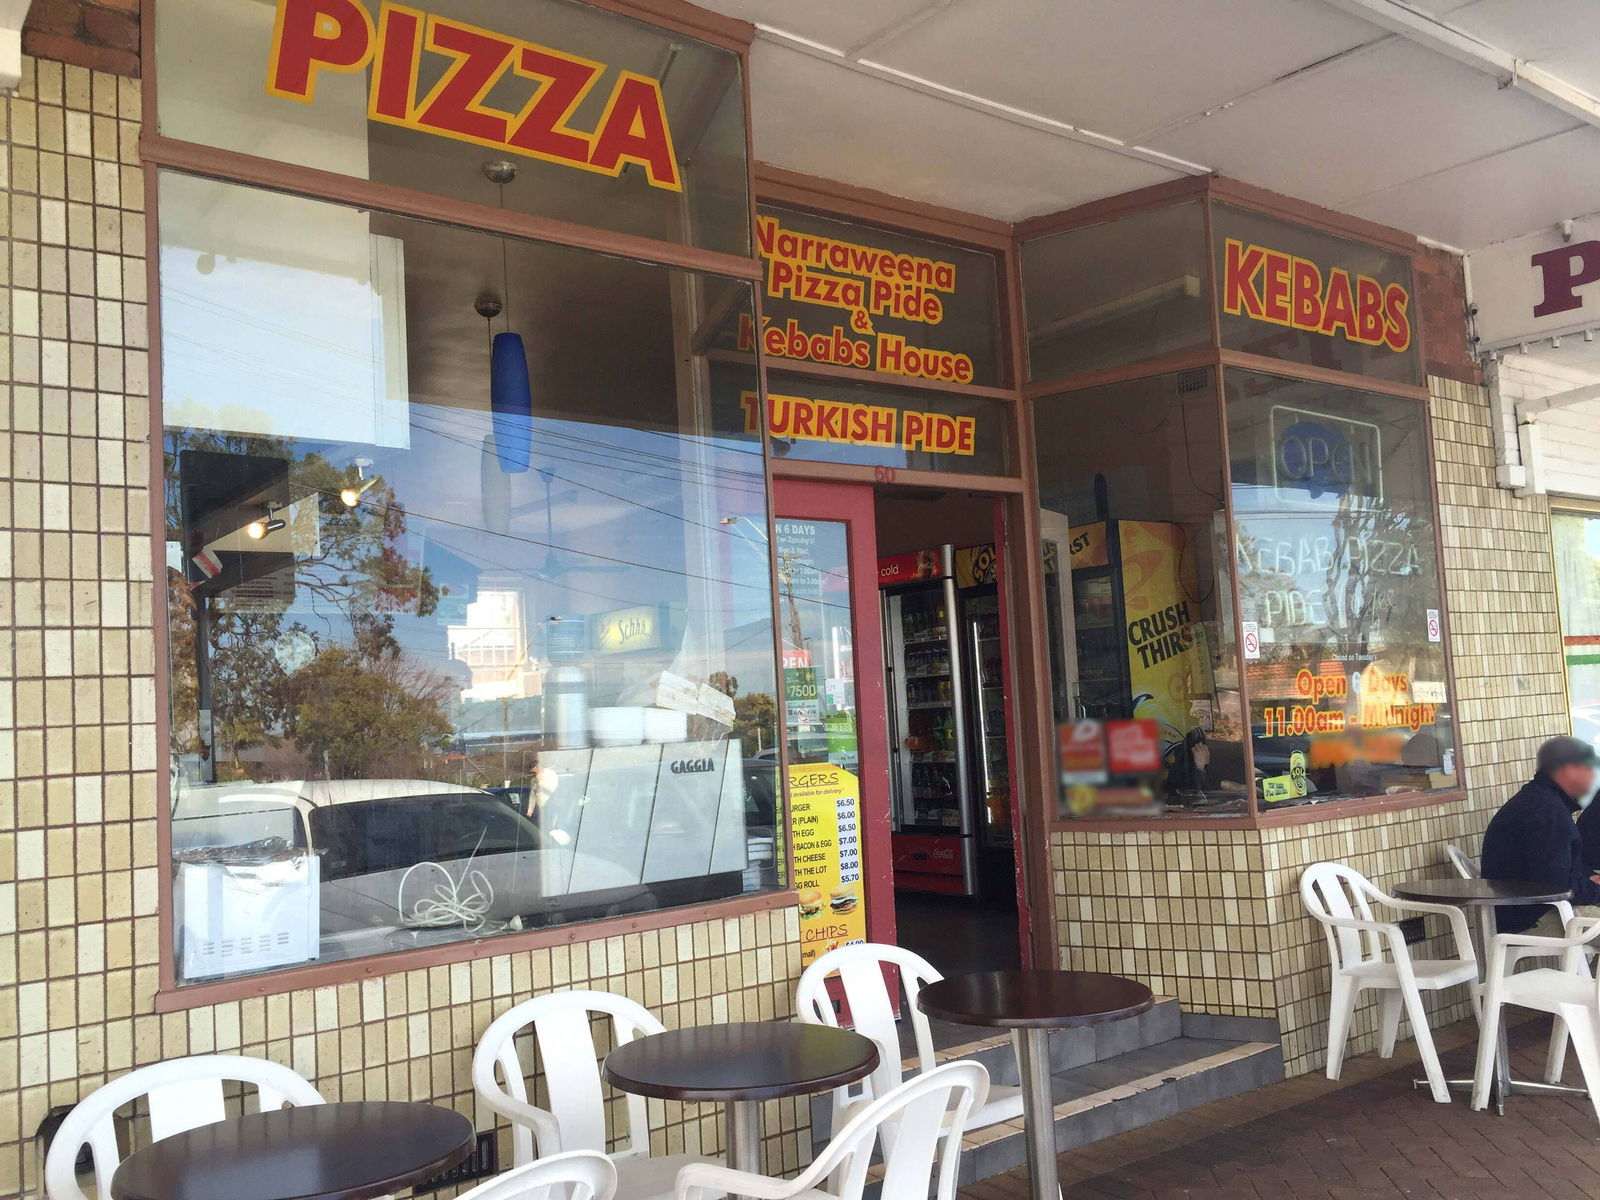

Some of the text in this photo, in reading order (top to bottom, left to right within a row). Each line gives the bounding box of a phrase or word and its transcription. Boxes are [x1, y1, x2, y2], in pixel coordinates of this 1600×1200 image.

[265, 0, 682, 193] PIZZA
[756, 215, 955, 293] Narraweena
[768, 260, 943, 325] Pizza Pide
[1224, 238, 1411, 352] KEBABS
[850, 308, 875, 335] &
[738, 313, 974, 384] Kebabs House
[741, 391, 976, 456] TURKISH PIDE
[784, 524, 790, 534] 6
[791, 524, 816, 535] DAYS
[1345, 536, 1422, 576] PIZZA
[880, 564, 899, 577] cold
[1265, 589, 1328, 627] PIDE
[1128, 601, 1191, 646] CRUSH
[1137, 625, 1194, 669] THIRS
[1331, 653, 1347, 661] Closed
[1296, 668, 1348, 705] Open
[1264, 705, 1345, 738] 11.00am
[671, 758, 715, 774] GAGGIA
[836, 798, 855, 808] $6.50
[798, 815, 819, 826] (PLAIN)
[837, 811, 856, 820] $6.00
[801, 829, 815, 837] EGG
[838, 823, 856, 833] $6.50
[796, 842, 815, 850] BACON
[820, 839, 832, 847] EGG
[839, 836, 857, 845] $7.00
[802, 853, 826, 863] CHEESE
[840, 848, 858, 858] $7.00
[803, 866, 815, 875] THE
[815, 865, 827, 874] LOT
[840, 861, 859, 871] $8.00
[803, 880, 819, 888] ROLL
[841, 873, 859, 883] $5.70
[805, 924, 848, 942] CHIPS
